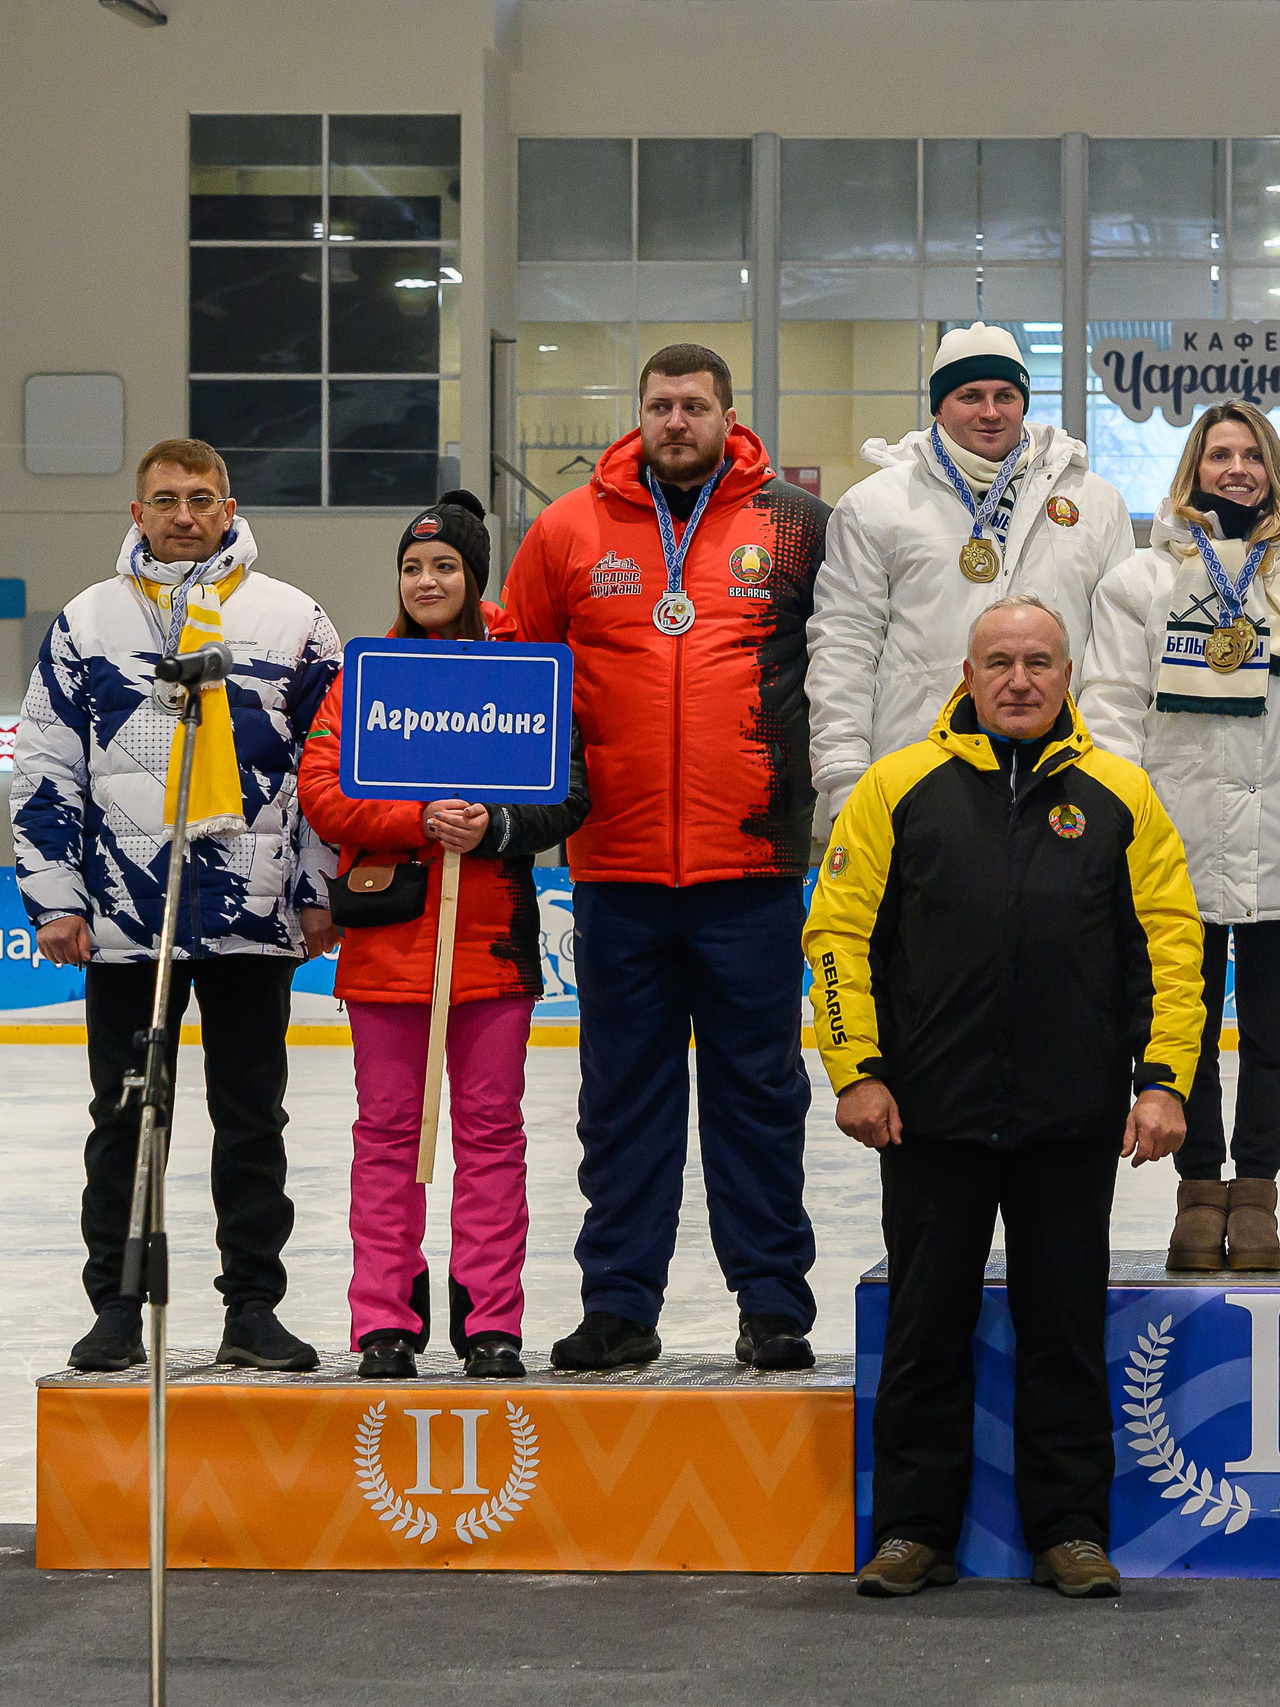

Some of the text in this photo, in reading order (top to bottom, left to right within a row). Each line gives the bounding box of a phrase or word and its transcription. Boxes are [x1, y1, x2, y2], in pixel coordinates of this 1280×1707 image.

[1184, 331, 1278, 352] КАФЕ
[728, 586, 771, 600] BELARUS
[1166, 636, 1206, 656] БЕЛЫ
[366, 700, 546, 740] Агрохолдинг
[821, 951, 848, 1046] BELARUS
[403, 1408, 489, 1495] II
